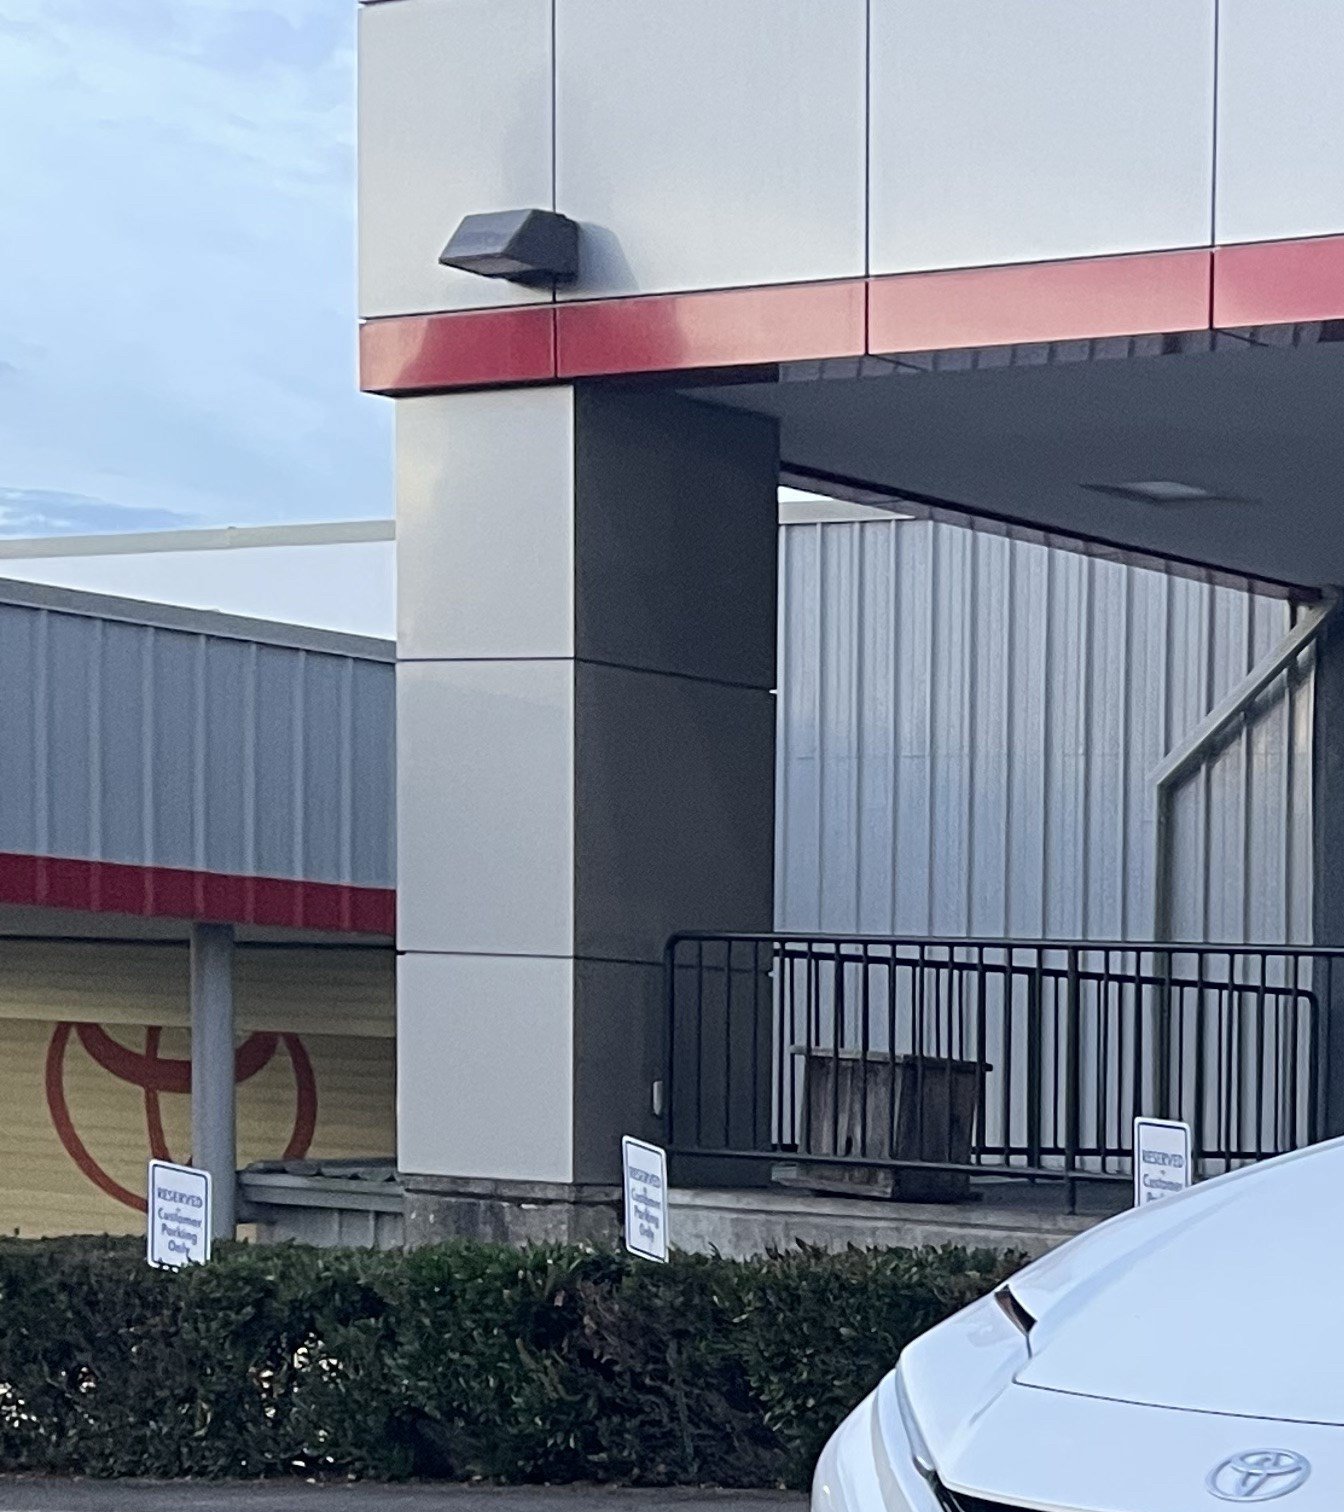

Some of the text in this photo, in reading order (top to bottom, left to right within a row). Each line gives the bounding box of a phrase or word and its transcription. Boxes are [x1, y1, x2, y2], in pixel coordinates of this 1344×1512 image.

[157, 1187, 203, 1210] RESERVED
[158, 1206, 203, 1229] Customer
[161, 1222, 198, 1246] Parking
